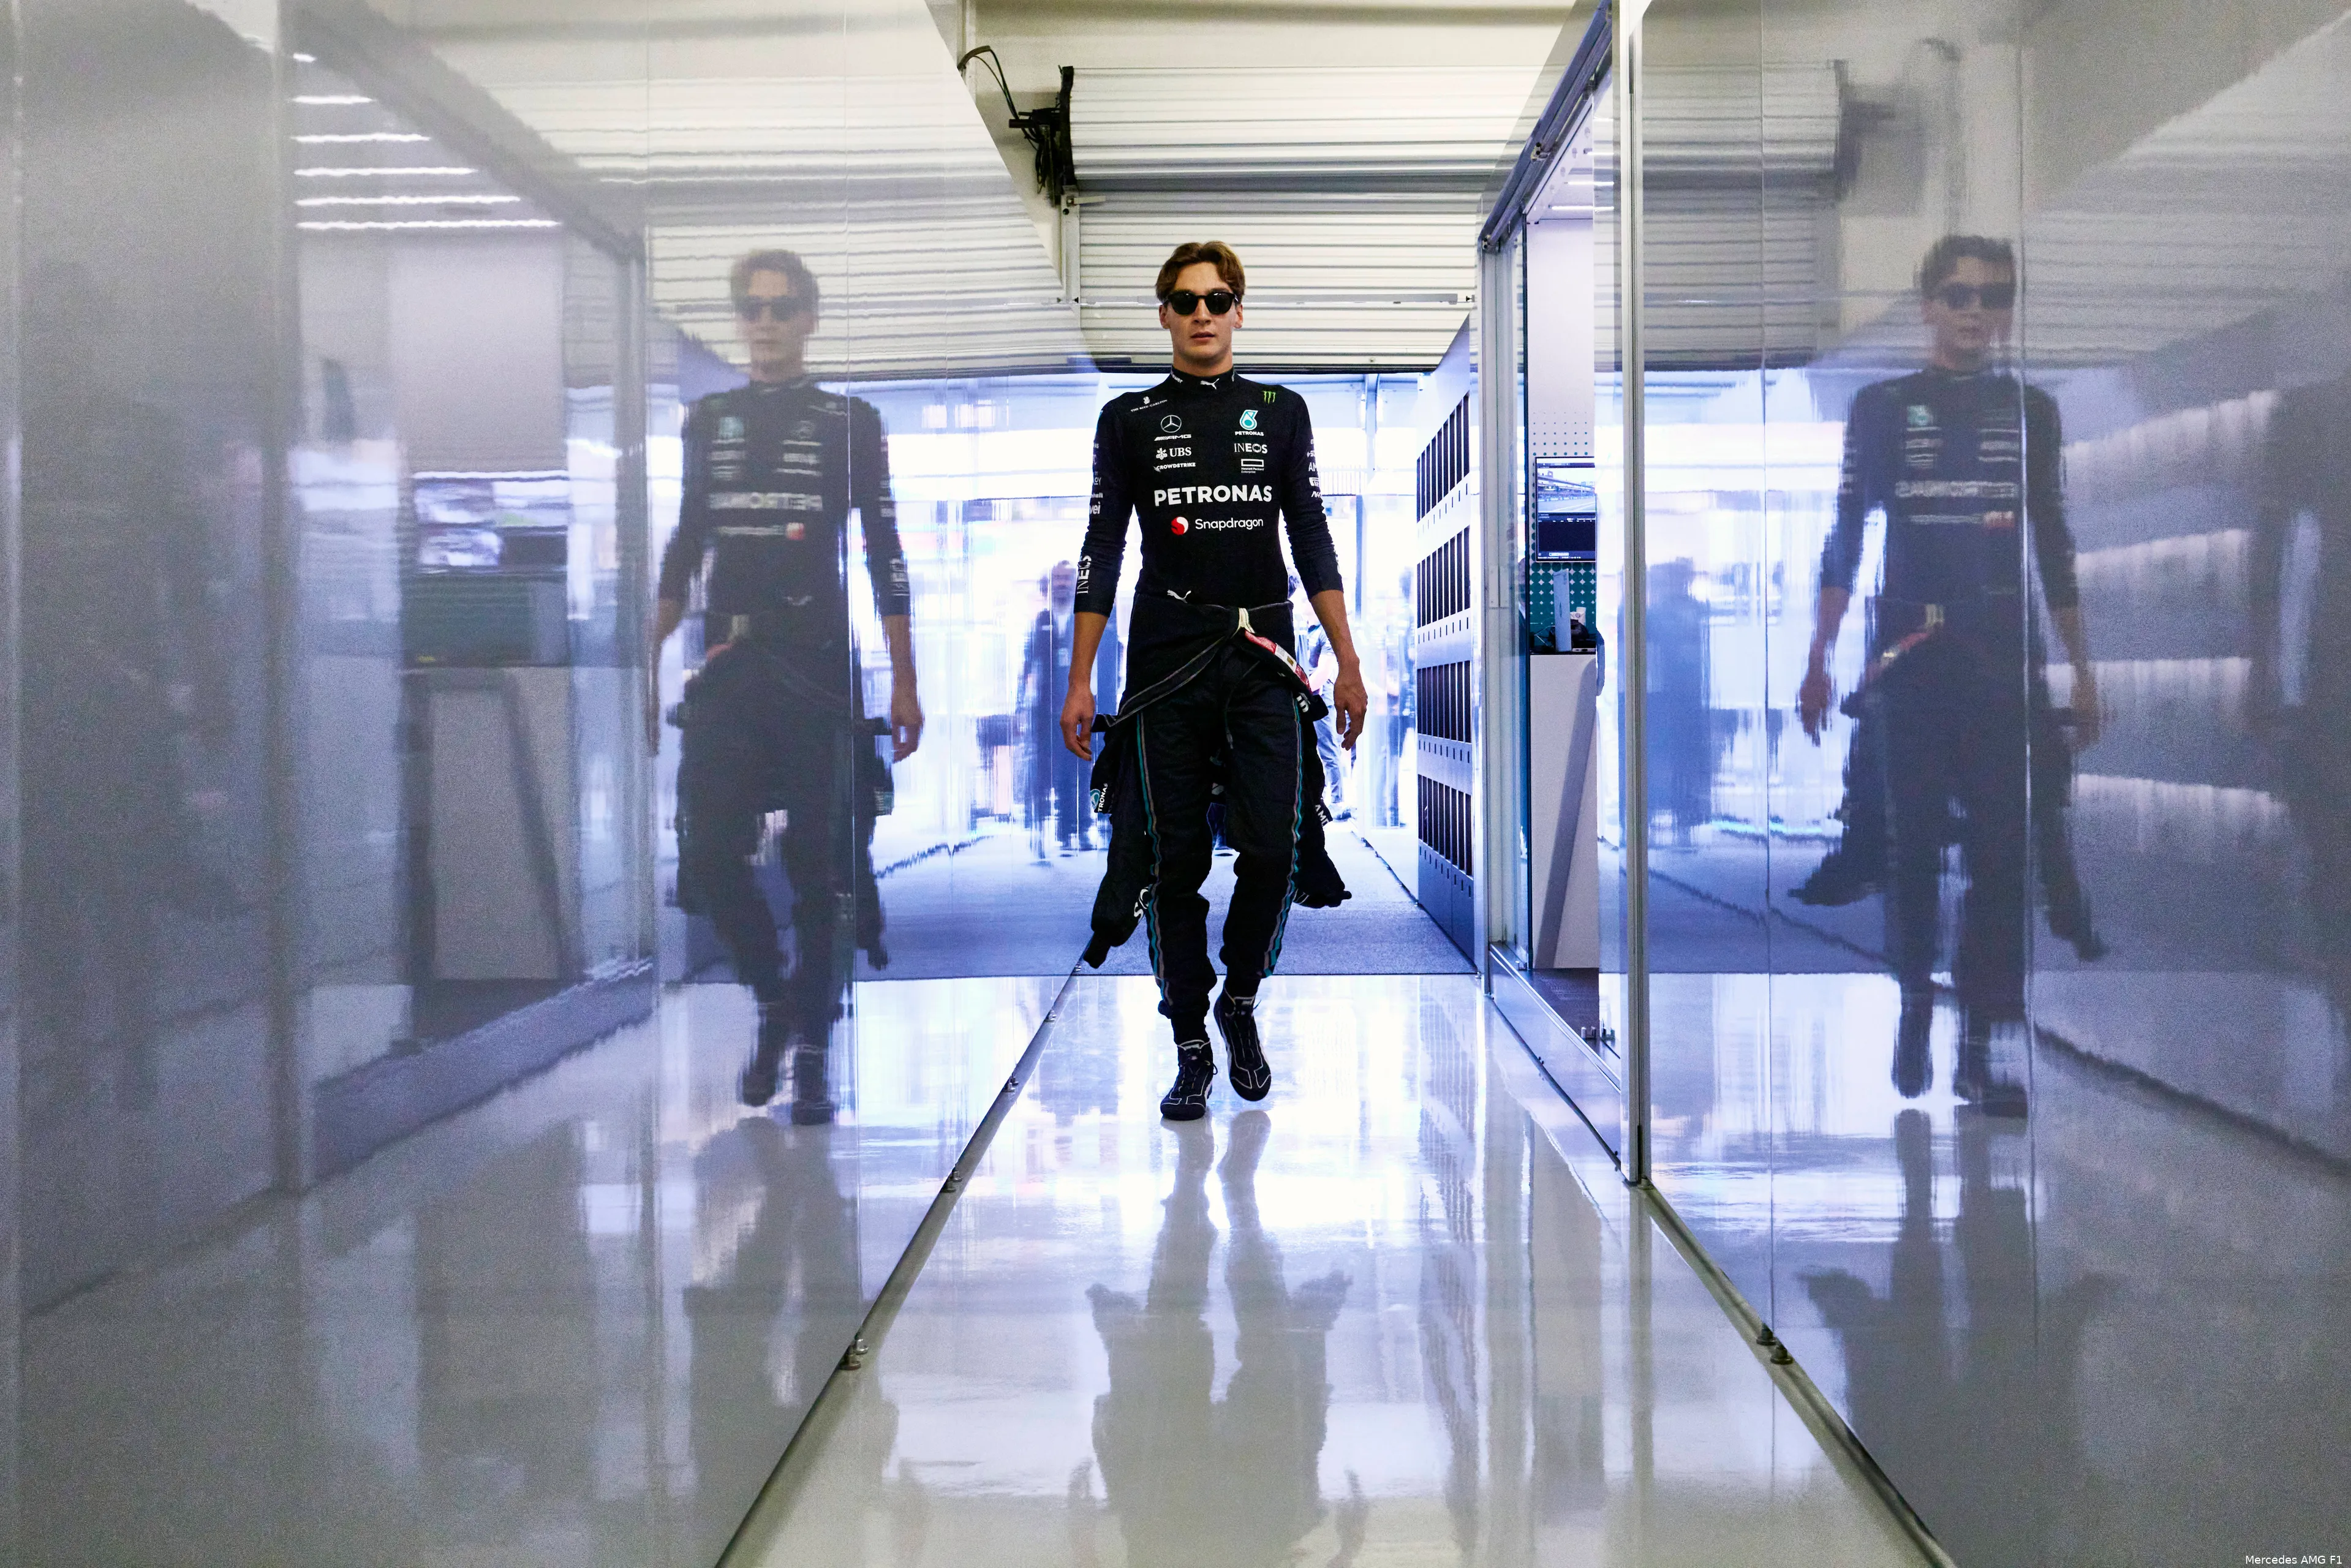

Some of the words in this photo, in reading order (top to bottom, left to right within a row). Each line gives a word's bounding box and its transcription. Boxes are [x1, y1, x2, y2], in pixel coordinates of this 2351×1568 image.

[1169, 447, 1192, 458] UBS
[1234, 443, 1268, 454] INEOS
[1156, 462, 1196, 470] CROWDSTRIKE
[1153, 484, 1273, 507] PETRONAS
[1194, 517, 1264, 531] Snapdragon
